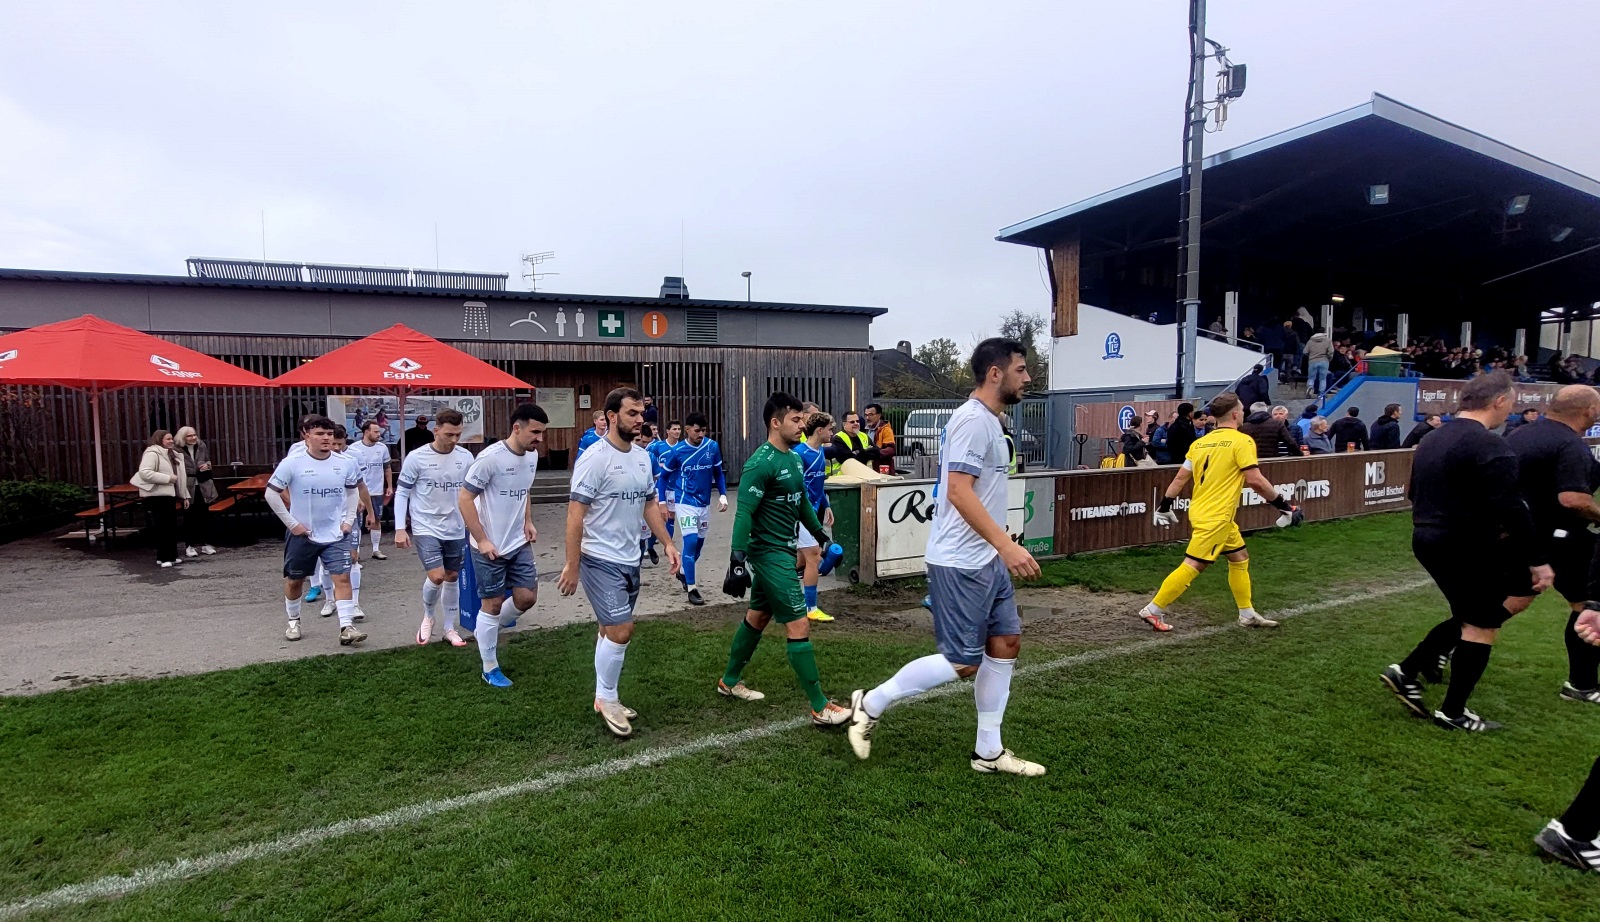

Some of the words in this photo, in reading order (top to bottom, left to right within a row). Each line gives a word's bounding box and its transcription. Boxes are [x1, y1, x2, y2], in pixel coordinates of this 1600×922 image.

[383, 371, 432, 380] Egger
[1365, 461, 1386, 486] MB
[311, 487, 344, 498] typico
[1364, 487, 1386, 499] Michael
[1386, 484, 1405, 496] Bischof
